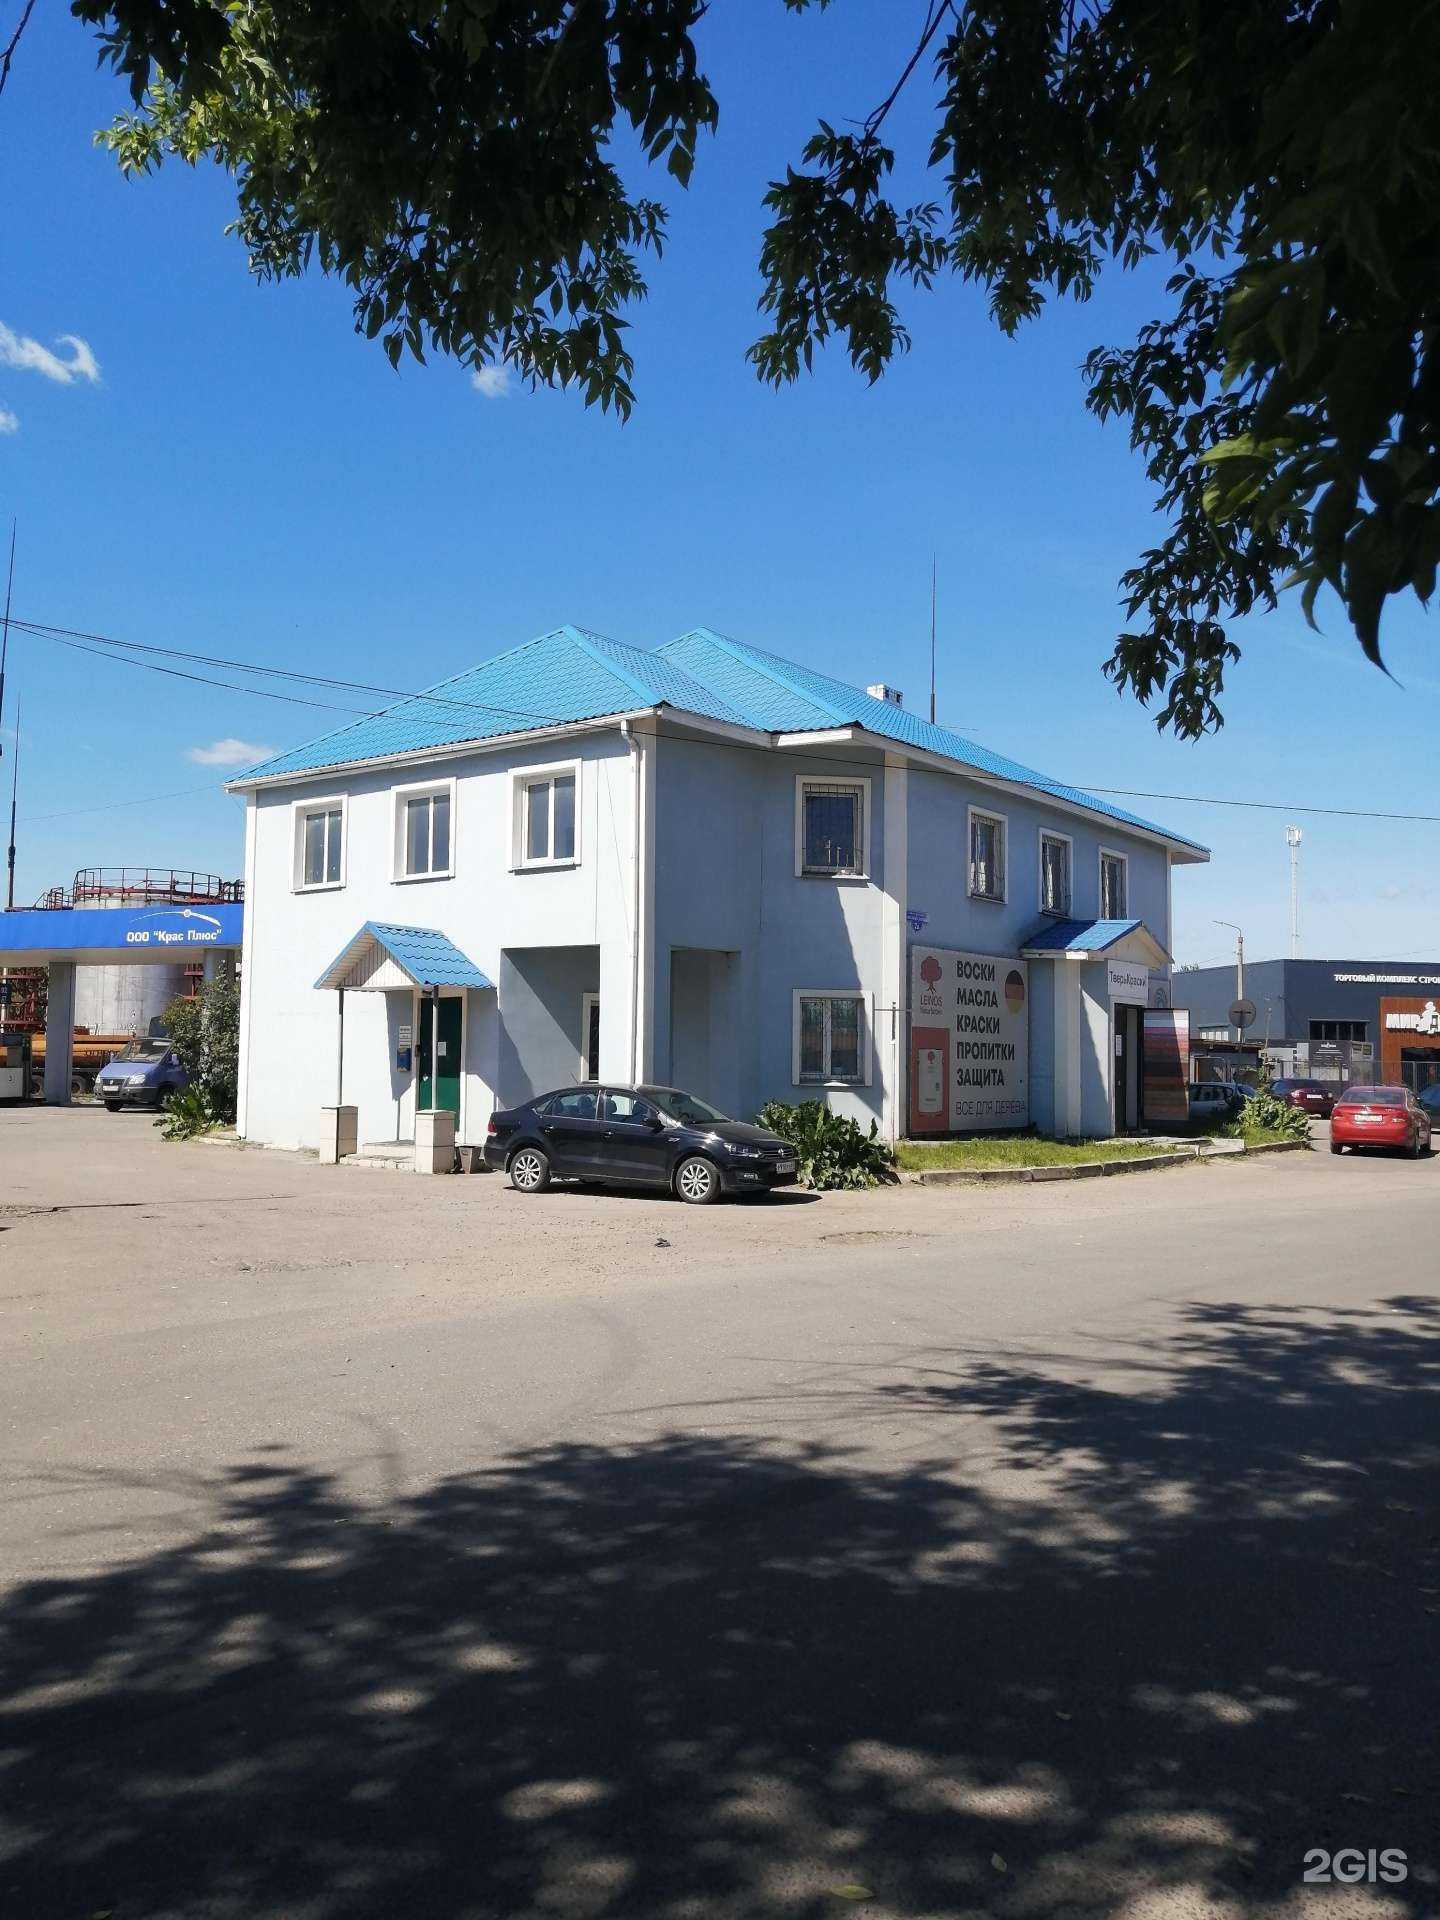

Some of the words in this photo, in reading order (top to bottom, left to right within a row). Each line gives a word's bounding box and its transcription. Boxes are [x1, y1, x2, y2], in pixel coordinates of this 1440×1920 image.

[127, 931, 150, 942] ООО
[154, 930, 184, 944] "Крас
[187, 929, 222, 942] Плюс"
[956, 960, 995, 982] ВОСКИ
[1334, 973, 1375, 983] ТОРГОВЫЙ
[1376, 975, 1418, 984] КОМПЛЕКС
[956, 987, 999, 1008] МАСЛА
[956, 1014, 1000, 1034] КРАСКИ
[956, 1041, 1015, 1061] ПРОПИТКИ
[956, 1068, 1005, 1088] ЗАЩИТА
[955, 1101, 975, 1116] ВСЕ
[976, 1100, 993, 1116] ДЛЯ
